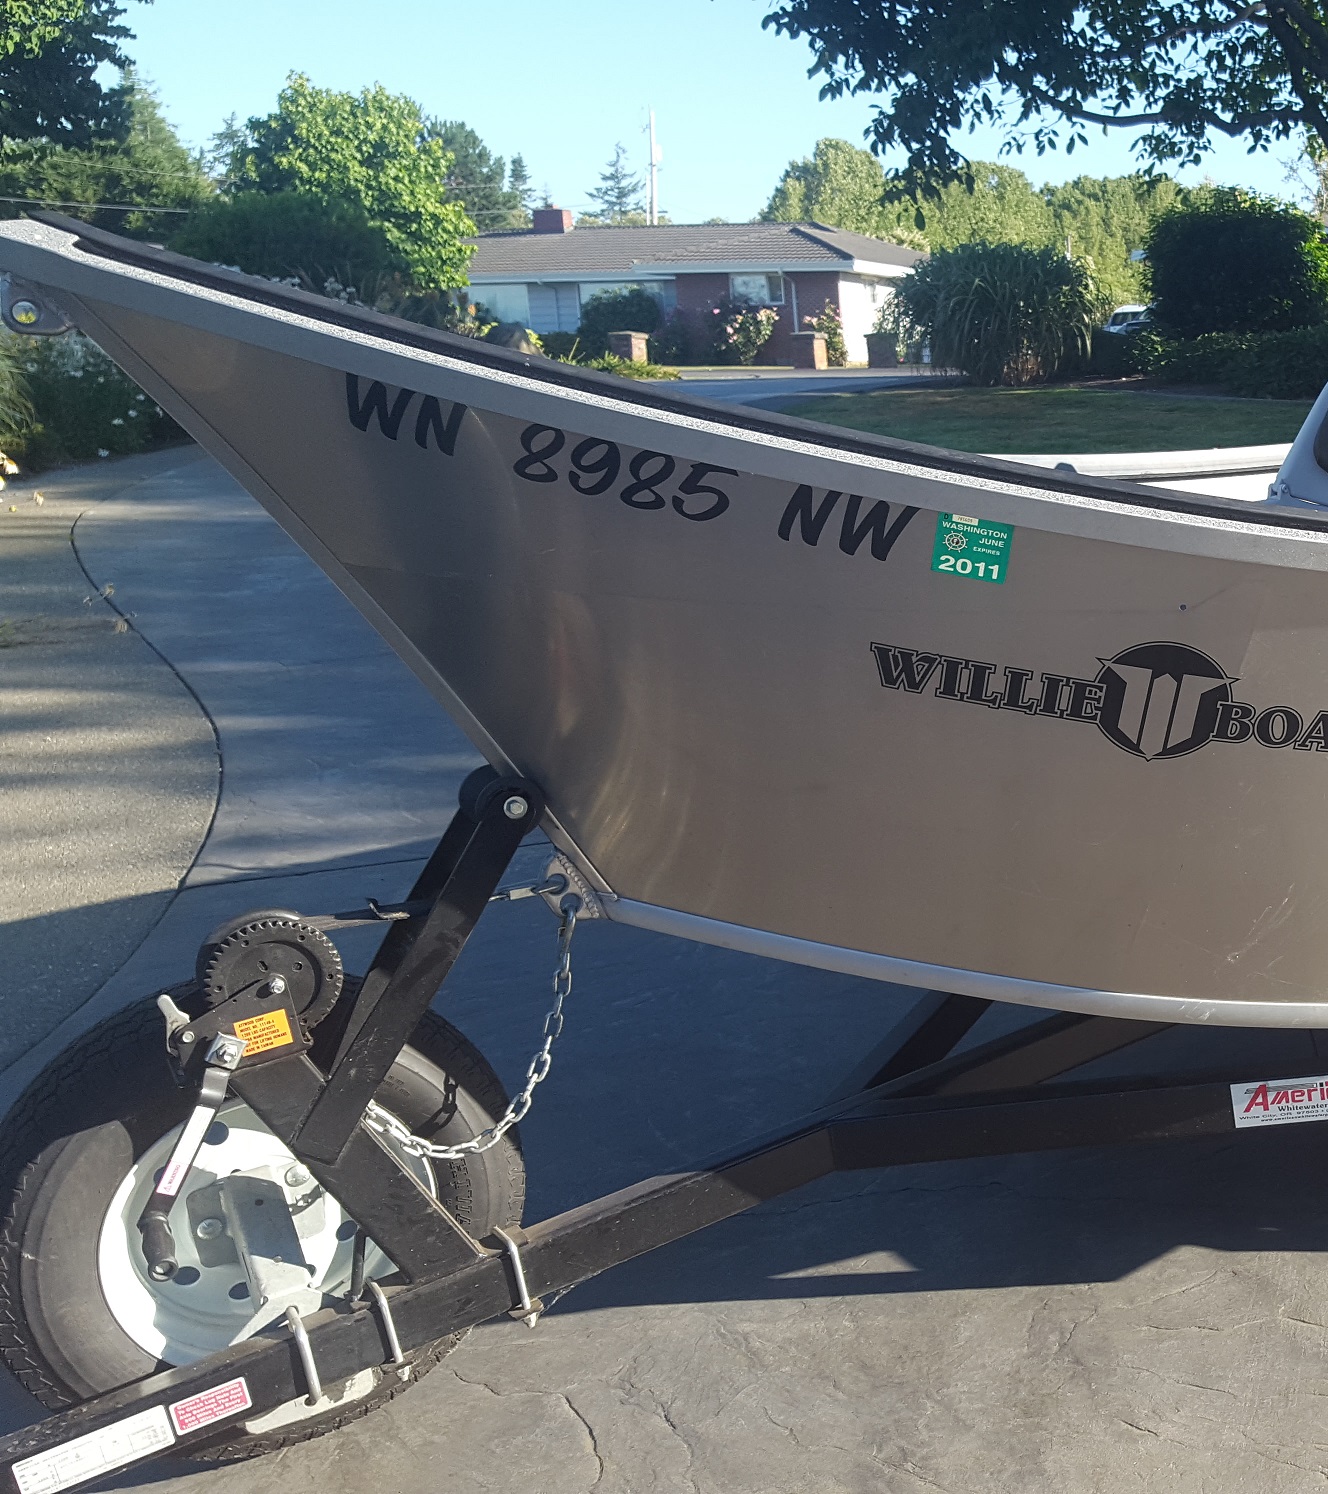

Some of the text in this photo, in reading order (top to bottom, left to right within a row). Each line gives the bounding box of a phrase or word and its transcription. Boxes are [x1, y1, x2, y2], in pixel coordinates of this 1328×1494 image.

[345, 373, 922, 562] WN 8985 NW
[942, 521, 1008, 539] WASHINGTON
[979, 538, 1005, 548] JUNE
[973, 546, 1000, 556] EXPIRES
[938, 555, 999, 580] 2011
[870, 641, 1106, 723] WILLIE
[259, 1024, 276, 1032] CAPACITY
[1277, 1102, 1328, 1112] Whitewater
